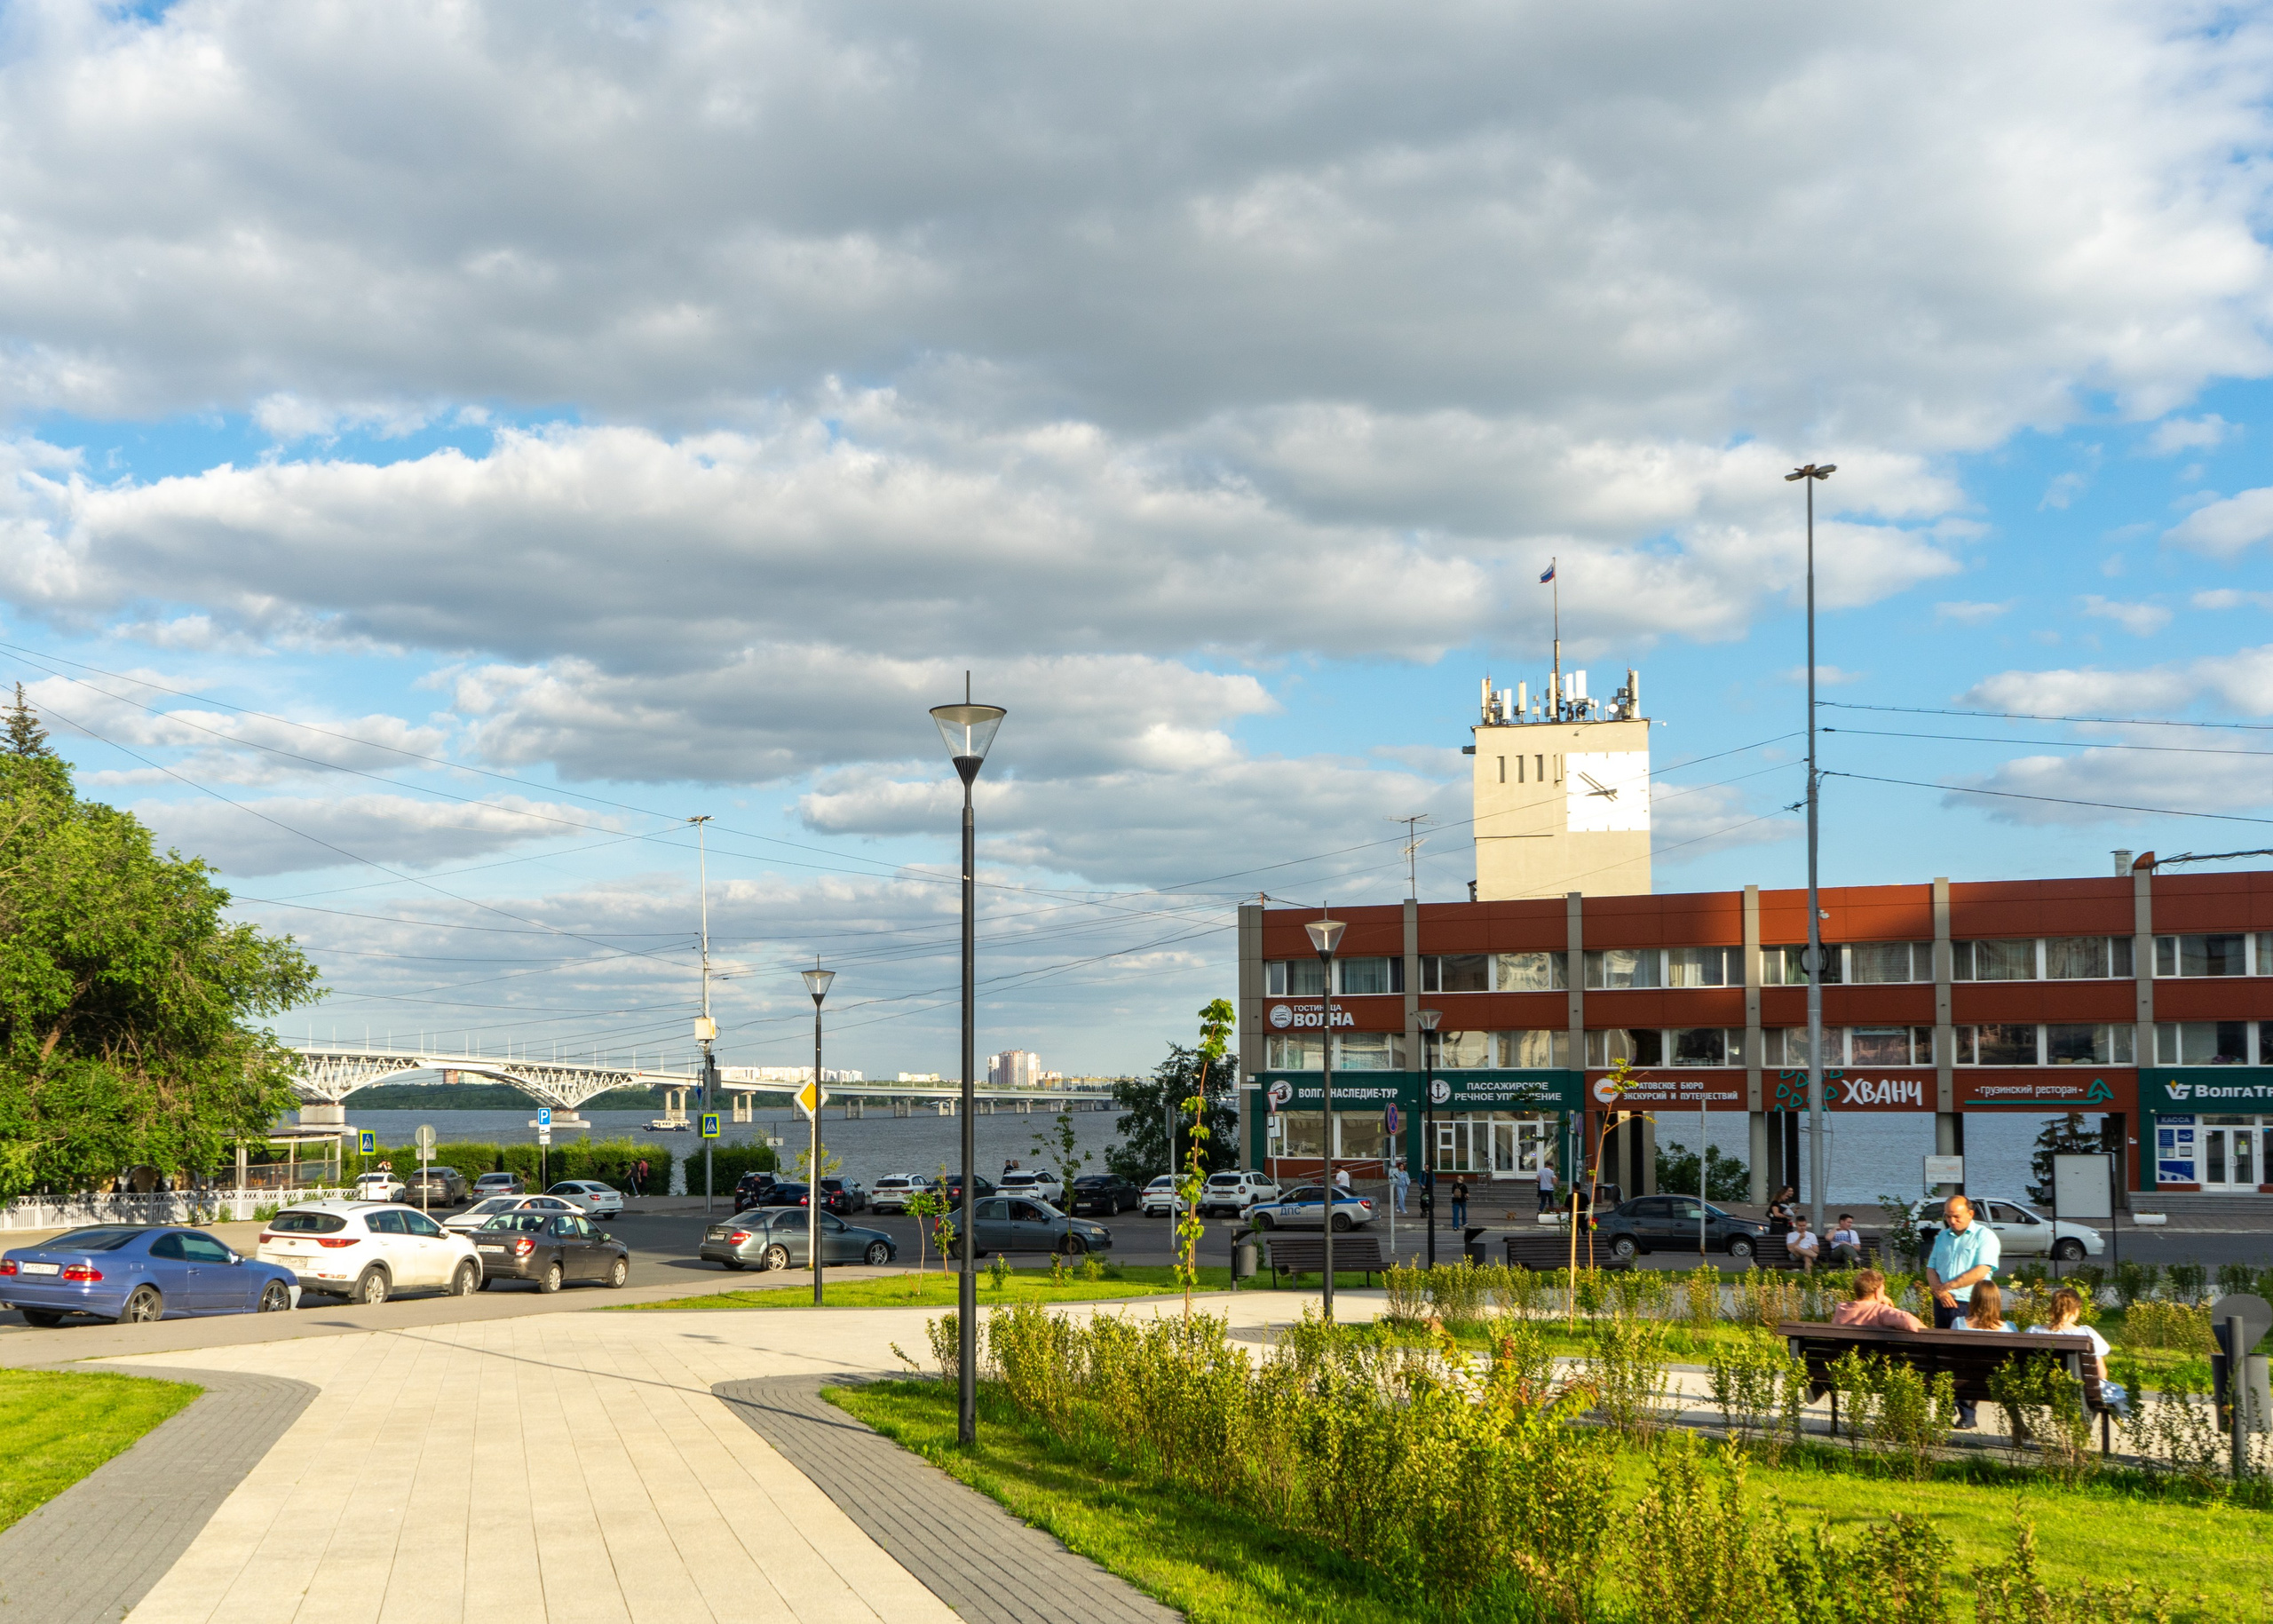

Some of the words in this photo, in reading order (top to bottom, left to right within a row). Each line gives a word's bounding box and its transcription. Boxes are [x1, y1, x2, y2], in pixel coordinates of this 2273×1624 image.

[1294, 1012, 1355, 1026] ВОЛНА
[1466, 1081, 1549, 1090] ПАССАЖИРСКОЕ
[1980, 1084, 2032, 1097] грузинский
[2035, 1085, 2078, 1097] ресторан
[1454, 1092, 1494, 1101] РЕЧНОЕ
[1496, 1092, 1562, 1101] УПРЕНИЕ
[1623, 1090, 1667, 1100] ЭКСКУРСИЙ
[540, 1110, 549, 1123] P
[1280, 1207, 1301, 1216] ДПС
